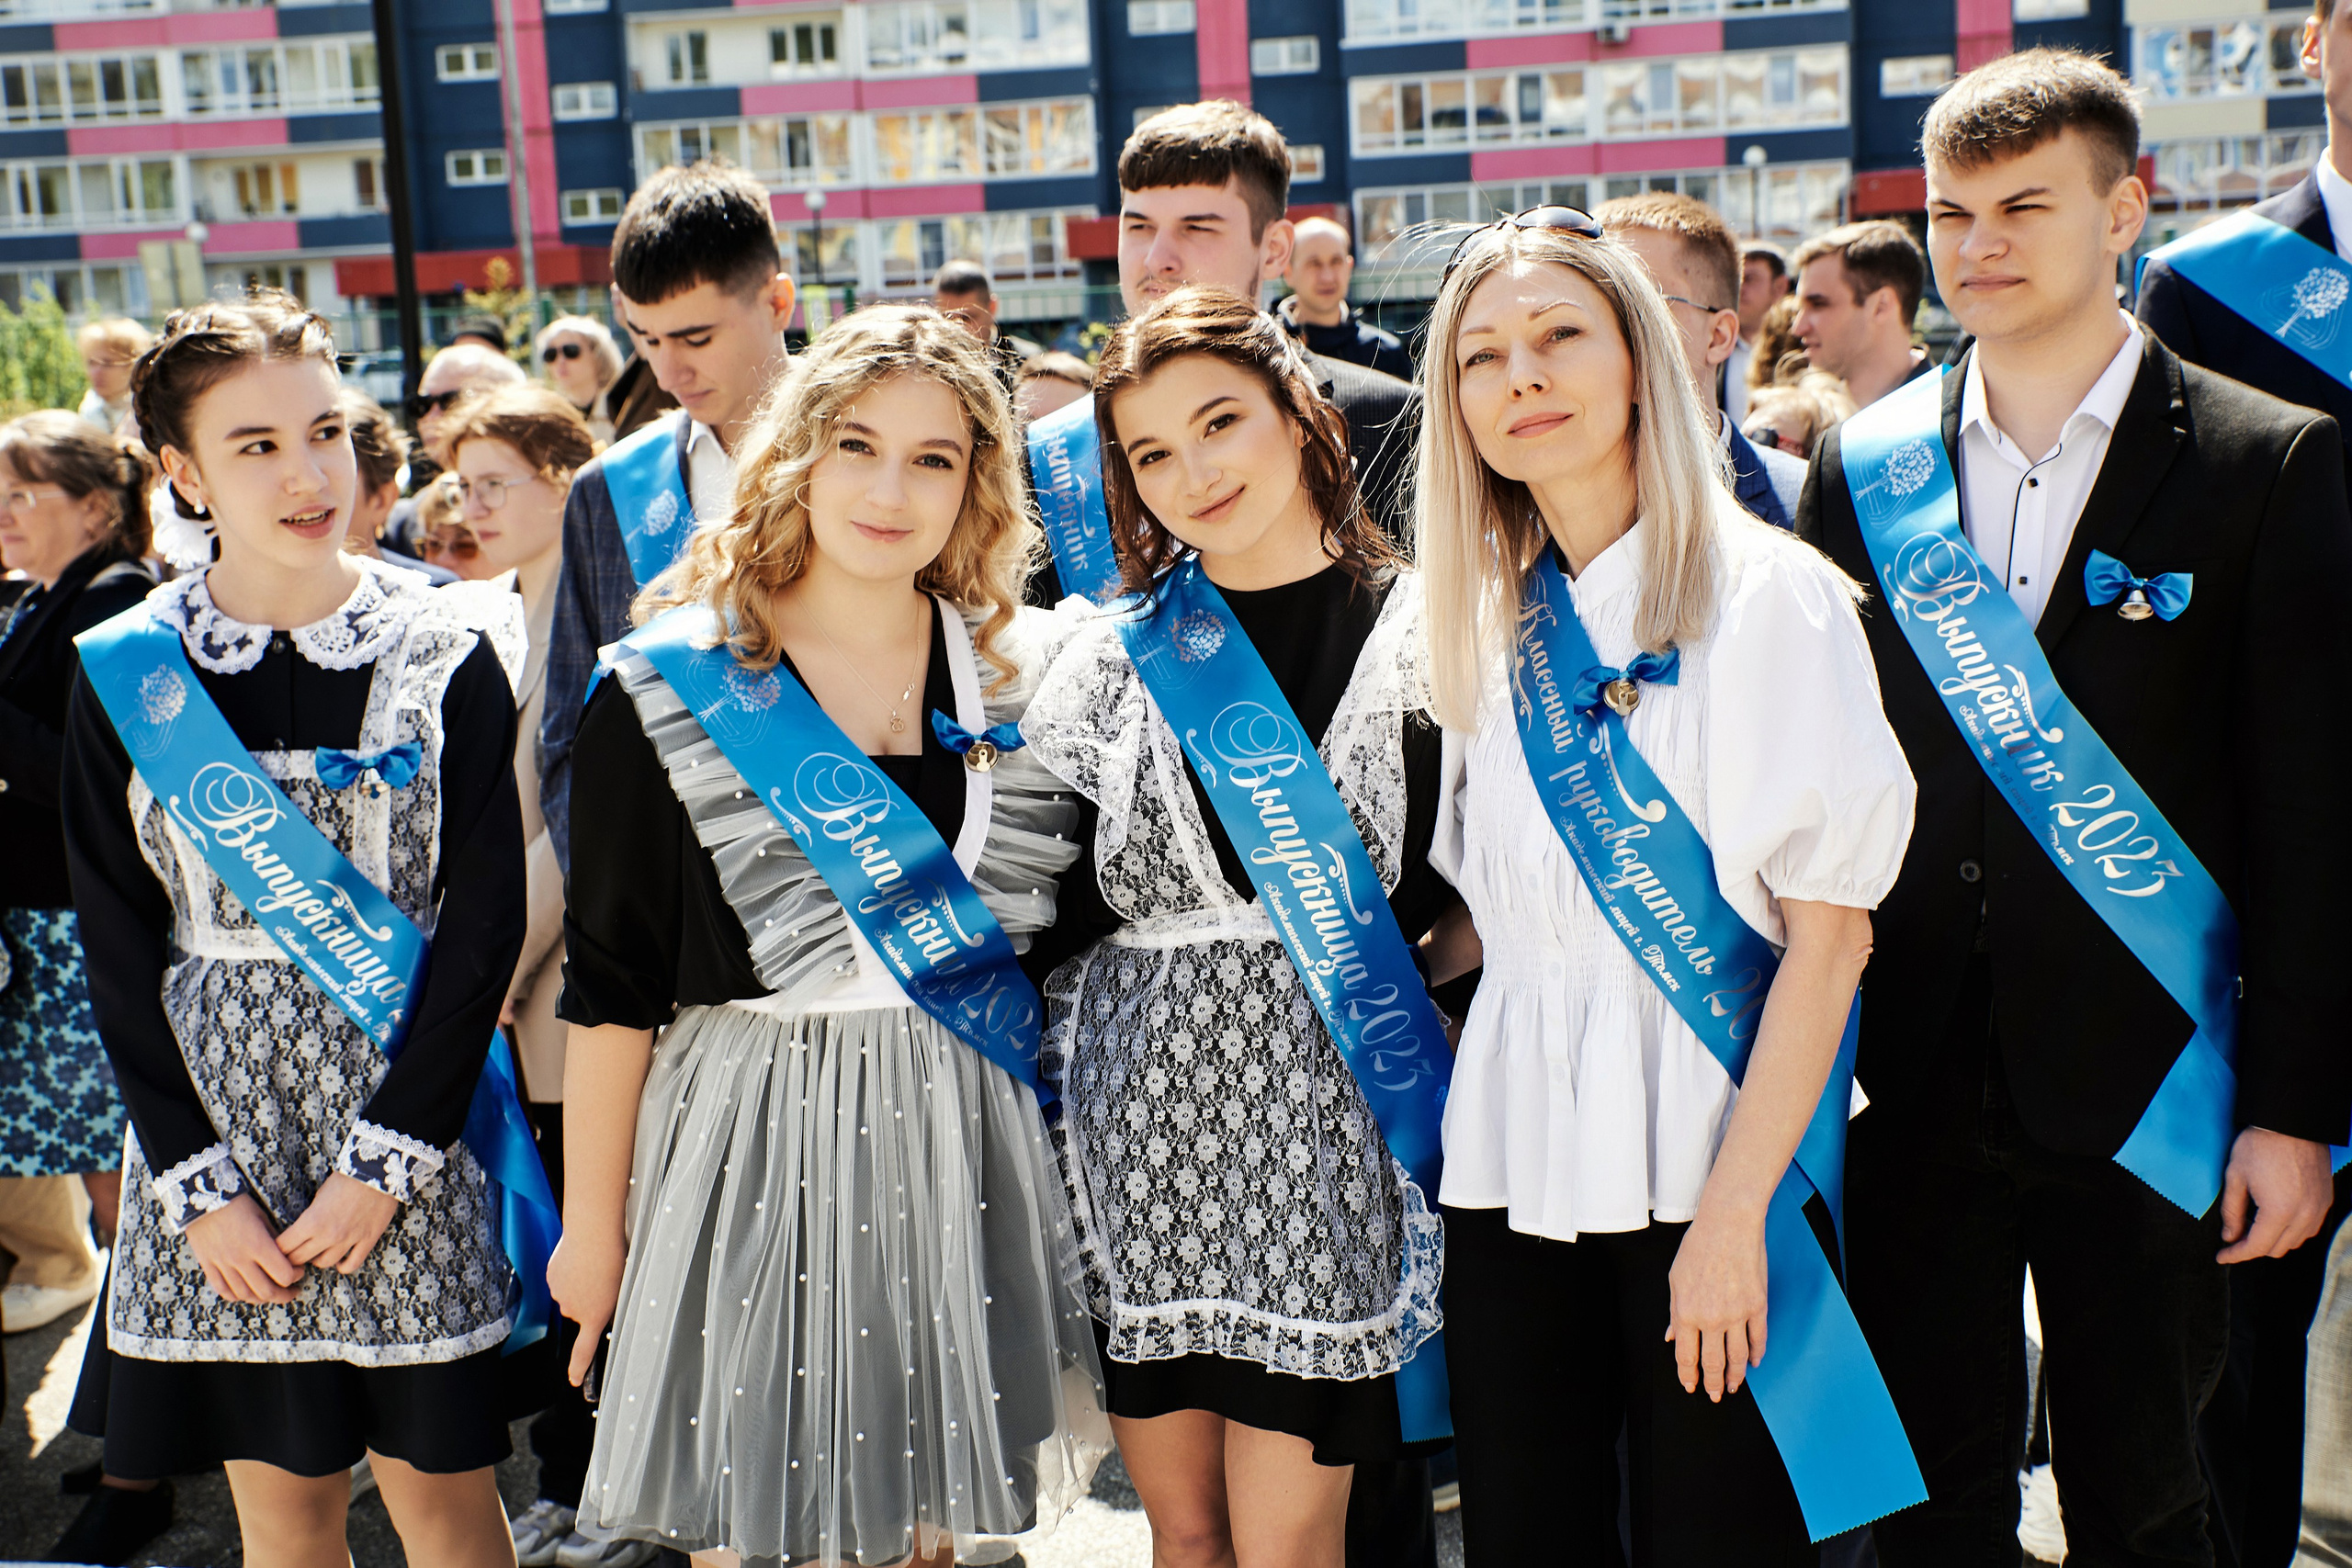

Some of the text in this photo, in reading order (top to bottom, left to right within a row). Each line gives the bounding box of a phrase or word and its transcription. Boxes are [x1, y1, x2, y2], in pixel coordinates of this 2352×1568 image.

[1516, 570, 1768, 1041] Классный руководитель 20
[1894, 531, 2185, 897] Выпускник 2023
[189, 761, 406, 1003] Выпускница
[275, 926, 373, 1026] Академический лицей г.
[794, 752, 971, 997] Выпускница
[1210, 701, 1435, 1091] Выпускница 2023
[1263, 881, 1355, 1052] Академический лицей г. Томск
[1560, 817, 1680, 992] Академический лицей г. Томск
[955, 1014, 989, 1047] Томск
